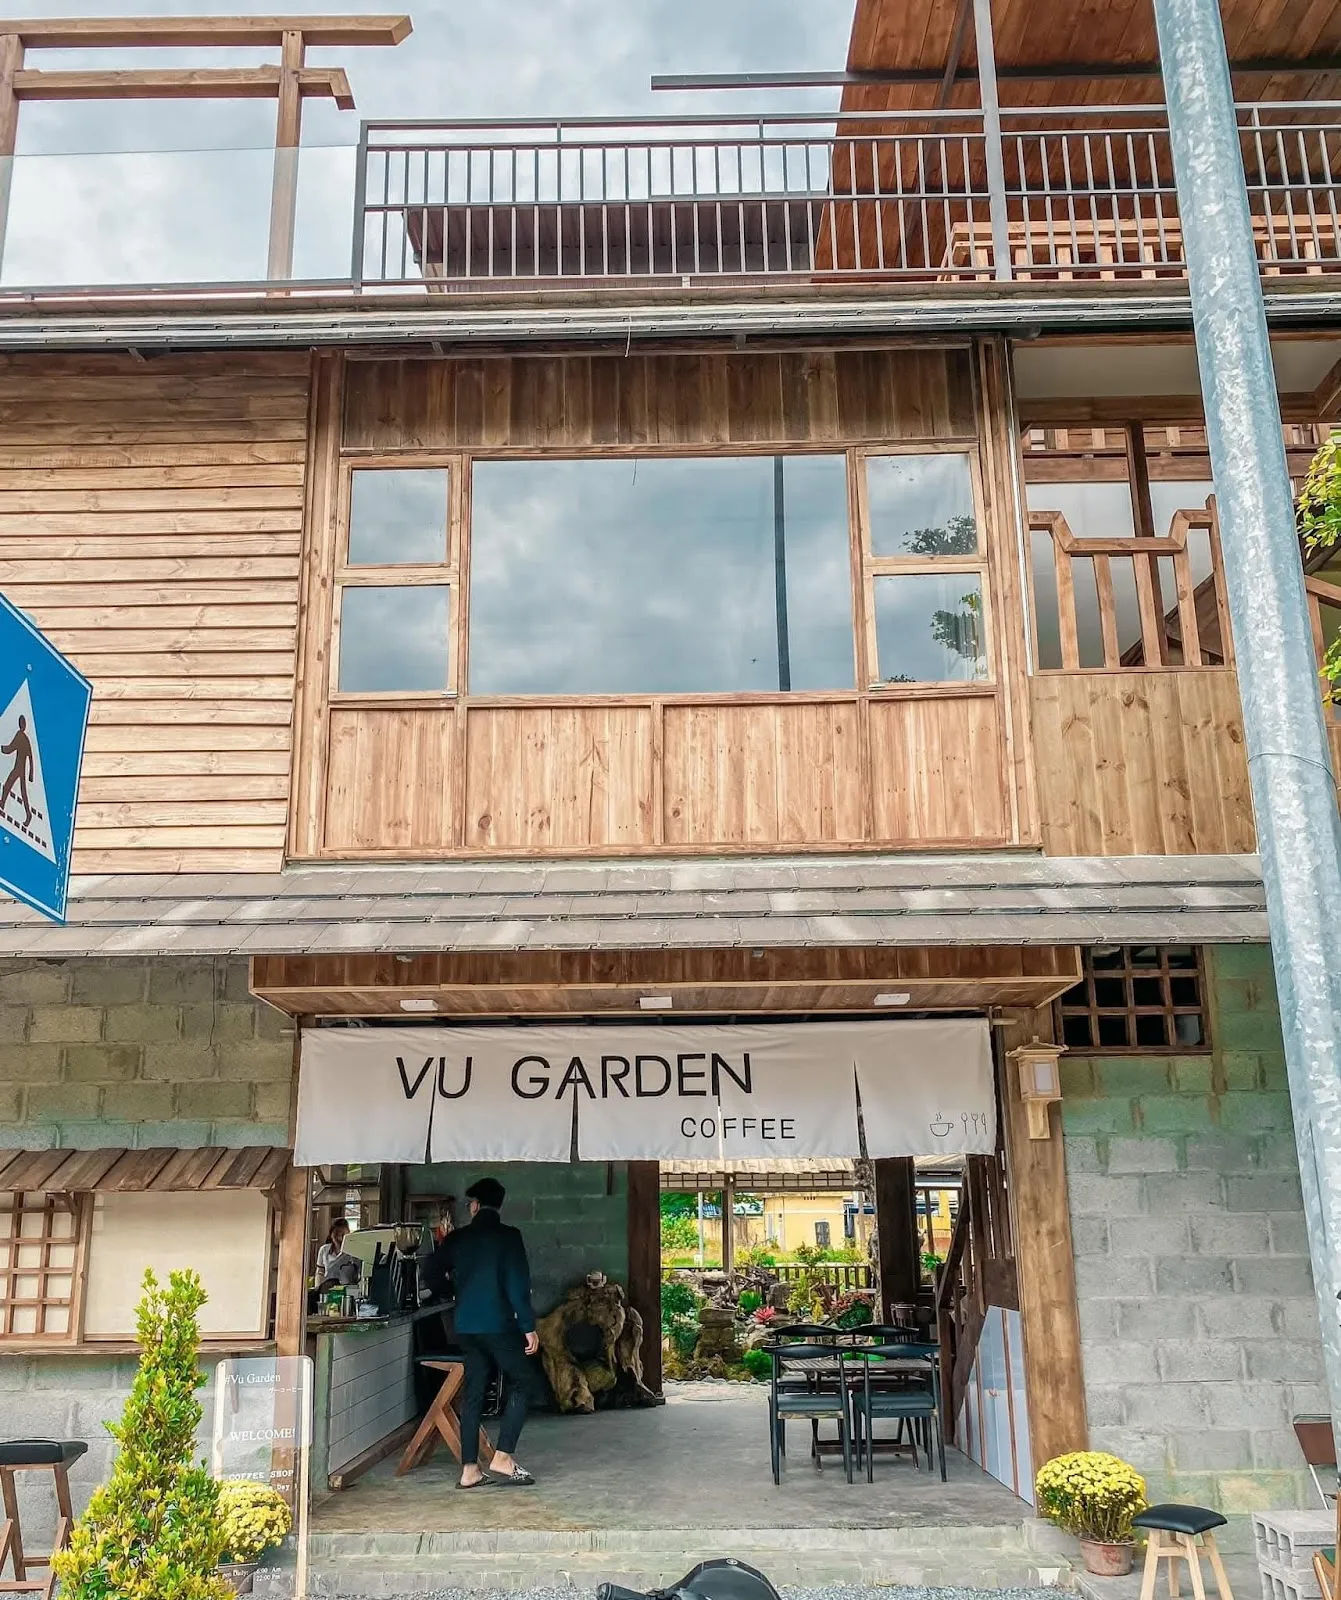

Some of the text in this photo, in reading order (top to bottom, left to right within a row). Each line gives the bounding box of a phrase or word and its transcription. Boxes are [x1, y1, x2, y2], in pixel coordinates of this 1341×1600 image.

[396, 1053, 752, 1100] VU GARDEN
[680, 1117, 796, 1140] COFFEE
[246, 1372, 281, 1384] Garden
[229, 1428, 296, 1441] WELCOME!
[228, 1469, 294, 1481] COFFEE SHOP
